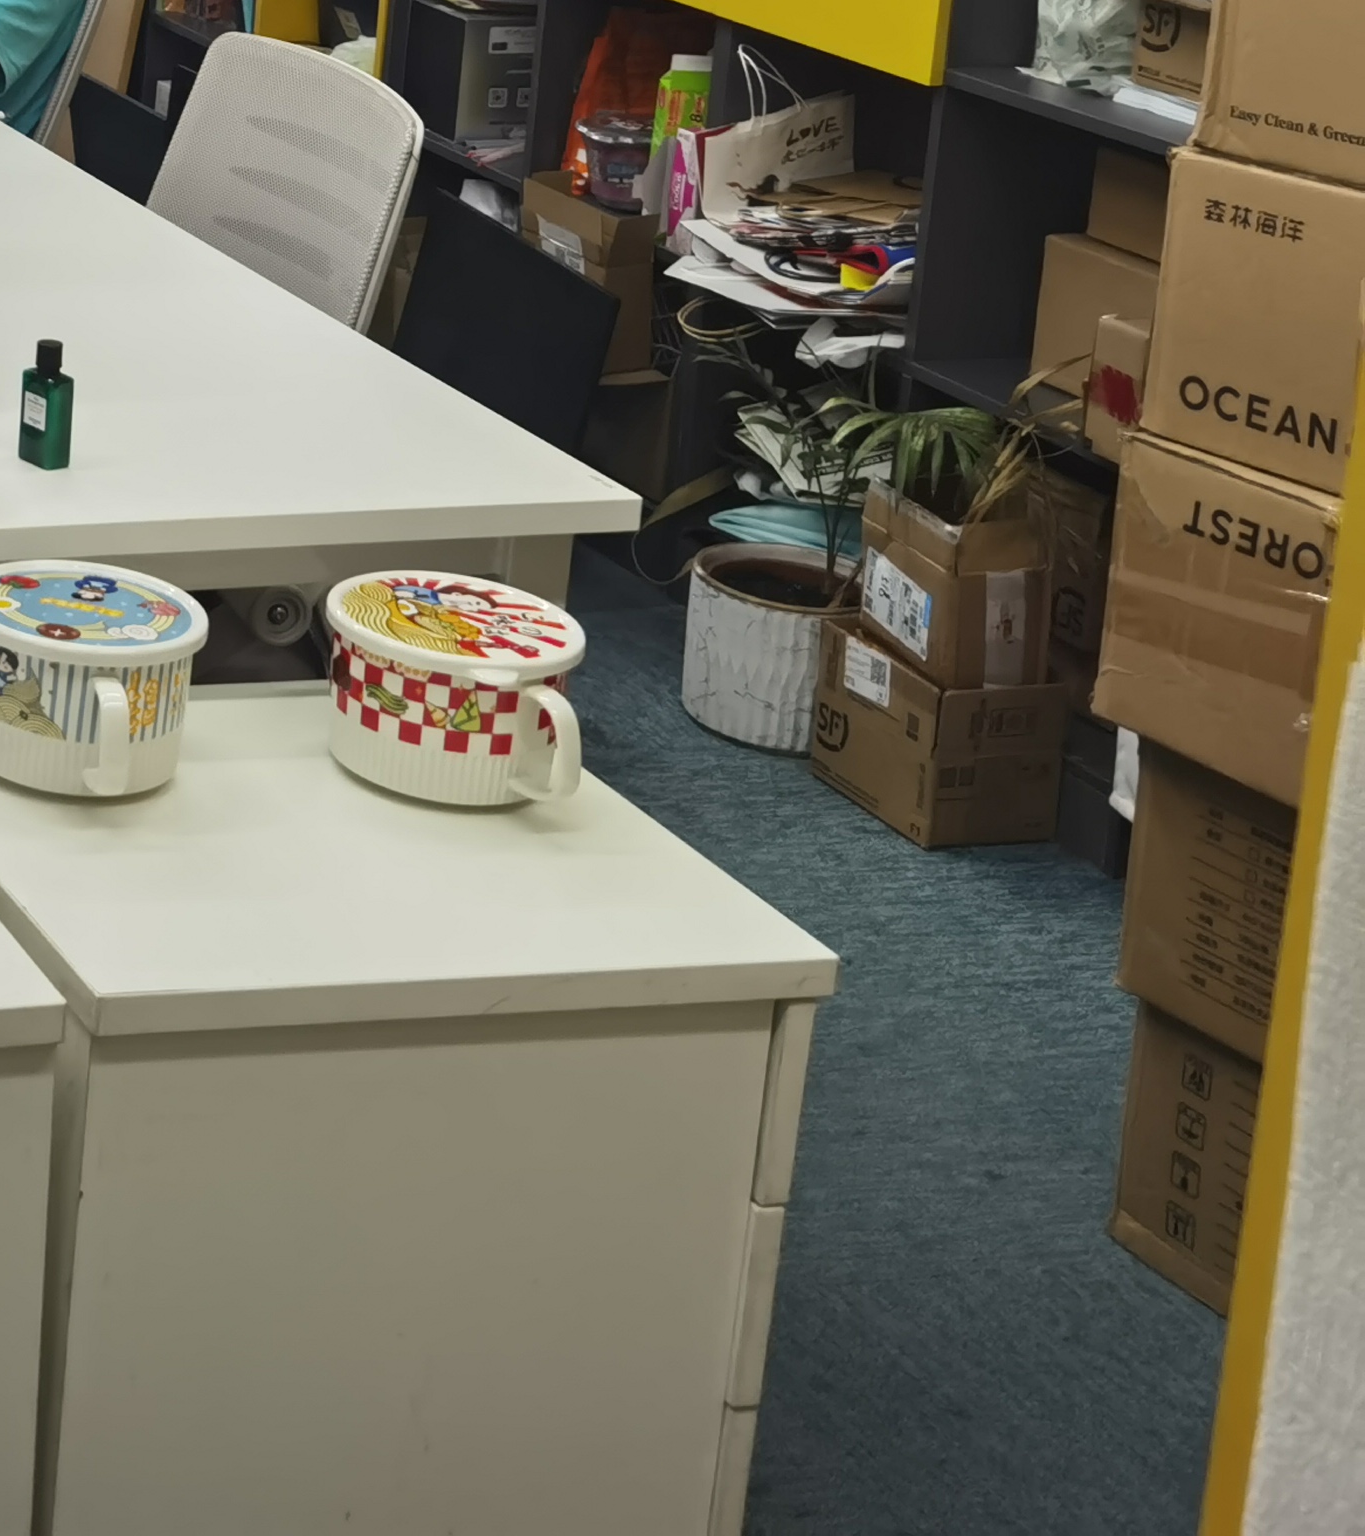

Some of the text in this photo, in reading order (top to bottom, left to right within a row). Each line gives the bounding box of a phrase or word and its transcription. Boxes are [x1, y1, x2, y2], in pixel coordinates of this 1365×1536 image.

[1229, 104, 1365, 150] Easy Clean & Green
[1203, 198, 1307, 244] 森林海洋
[1179, 375, 1349, 457] OCEAN
[1182, 500, 1330, 587] OREST
